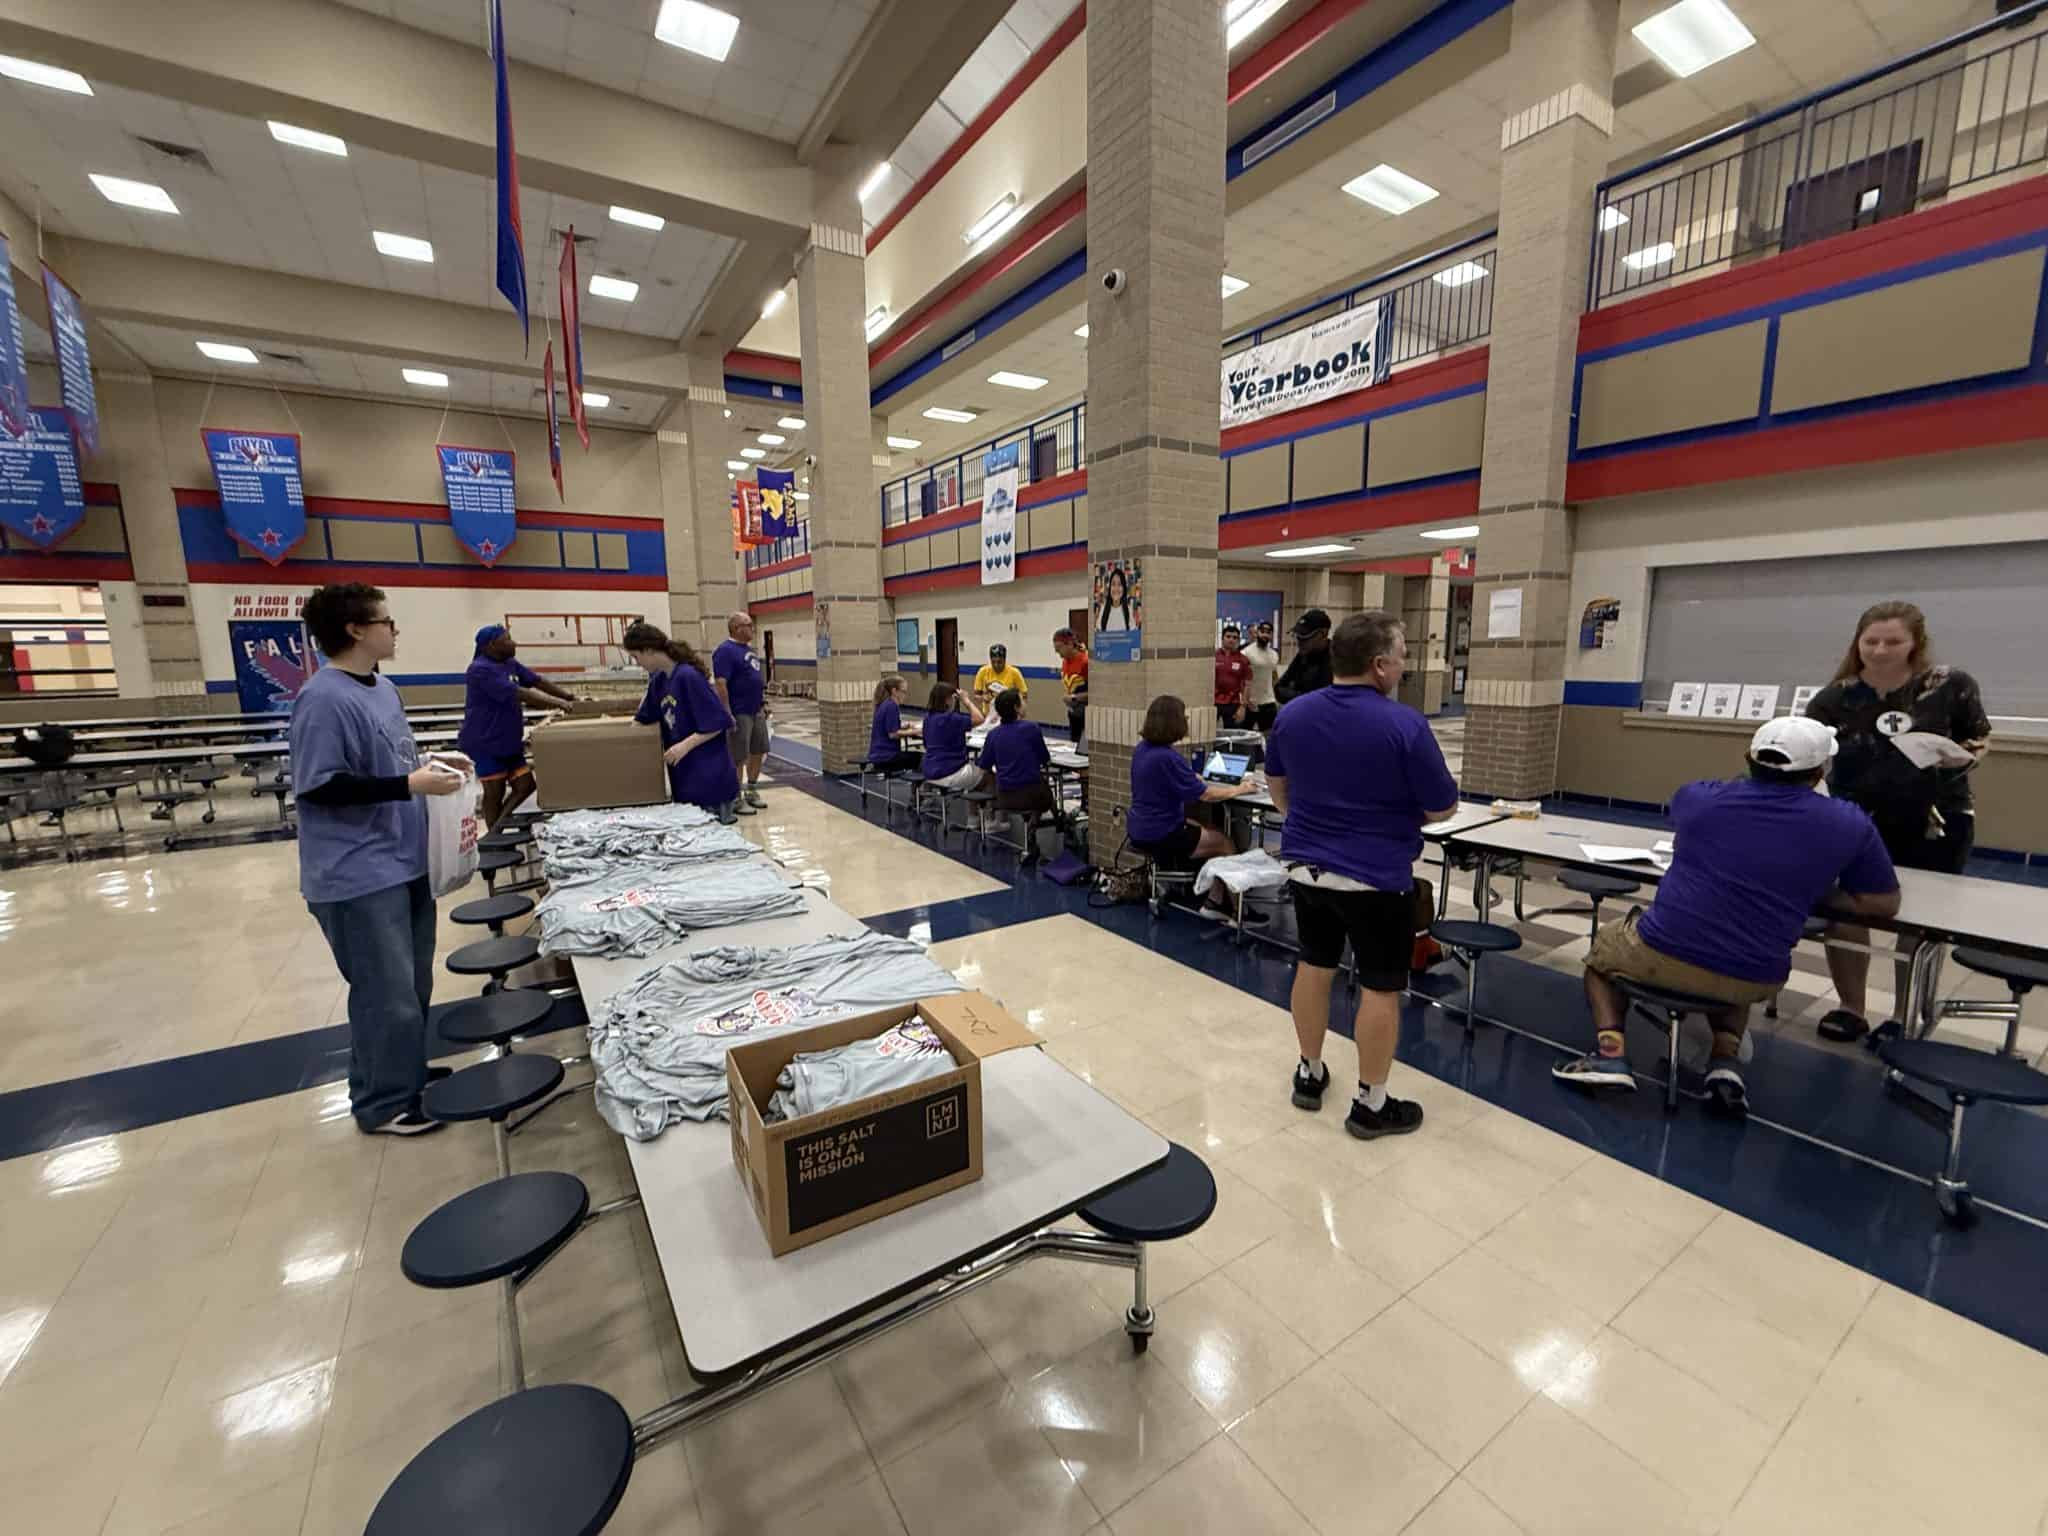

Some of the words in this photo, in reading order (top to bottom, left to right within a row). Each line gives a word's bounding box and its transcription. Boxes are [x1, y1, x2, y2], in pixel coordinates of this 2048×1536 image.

[1228, 365, 1259, 384] Your
[1229, 340, 1371, 405] Yearbook
[234, 595, 251, 606] NO
[258, 595, 288, 606] FOOD
[295, 595, 308, 606] O
[234, 607, 288, 617] ALLOWED
[798, 1136, 834, 1158] THIS
[838, 1123, 876, 1146] SALT
[800, 1157, 813, 1170] IS
[818, 1149, 842, 1164] ON
[846, 1143, 857, 1156] A
[800, 1151, 865, 1184] MISSION
